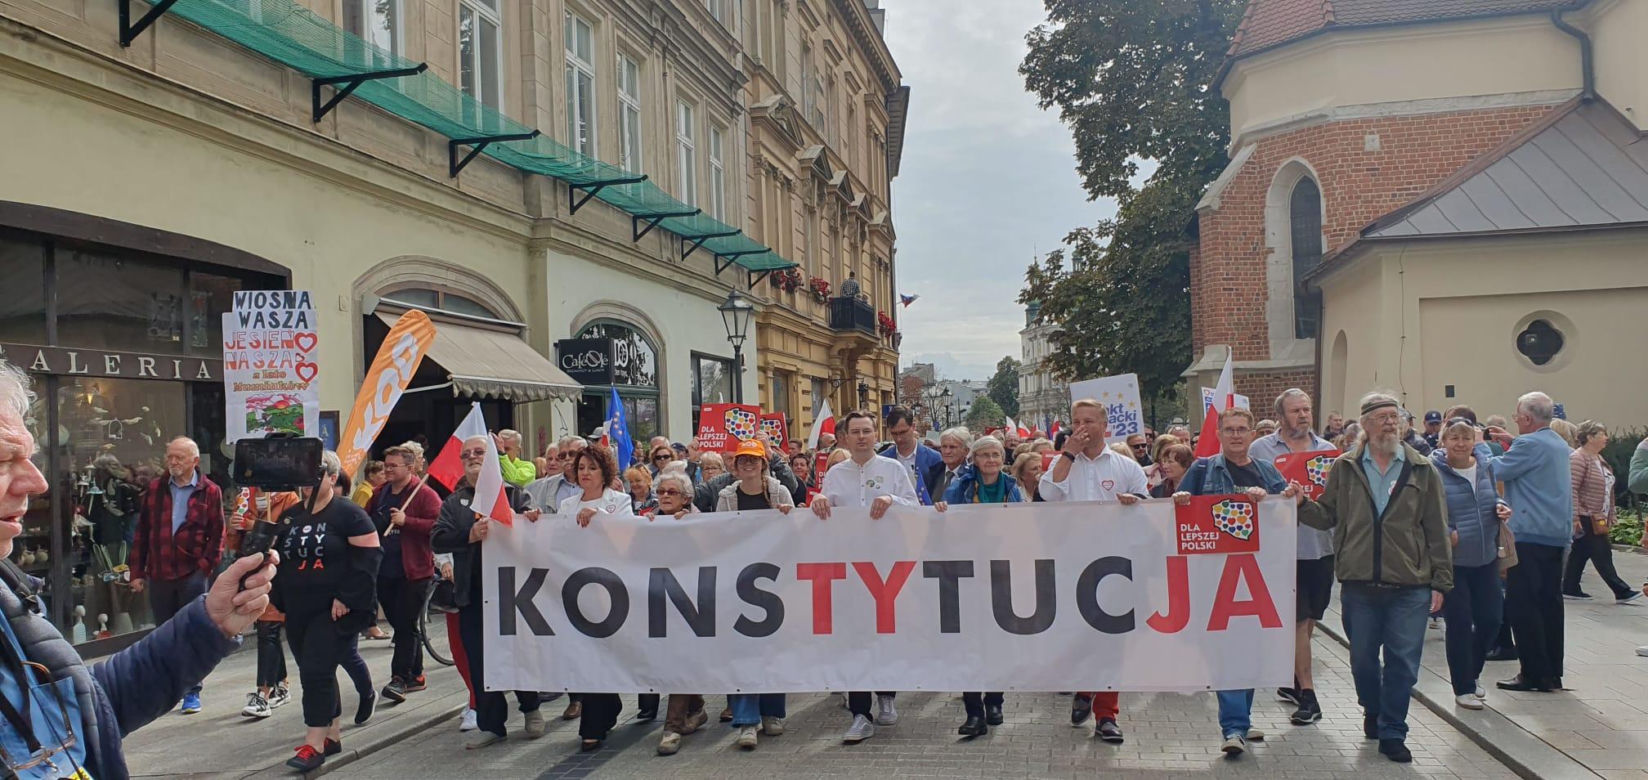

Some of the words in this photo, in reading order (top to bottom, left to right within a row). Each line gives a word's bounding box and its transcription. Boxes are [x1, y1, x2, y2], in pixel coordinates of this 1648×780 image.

[235, 291, 311, 309] WIOSNA
[239, 311, 308, 329] WASZA
[0, 345, 211, 379] ALERIA
[225, 351, 293, 370] NASZA
[353, 332, 419, 452] KOD
[1109, 410, 1137, 423] acki
[1180, 523, 1200, 532] DLA
[1180, 532, 1219, 541] LEPSZEJ
[1181, 541, 1216, 550] POLSKI
[298, 558, 324, 570] JA
[498, 554, 1283, 638] KONSTYTUCJA
